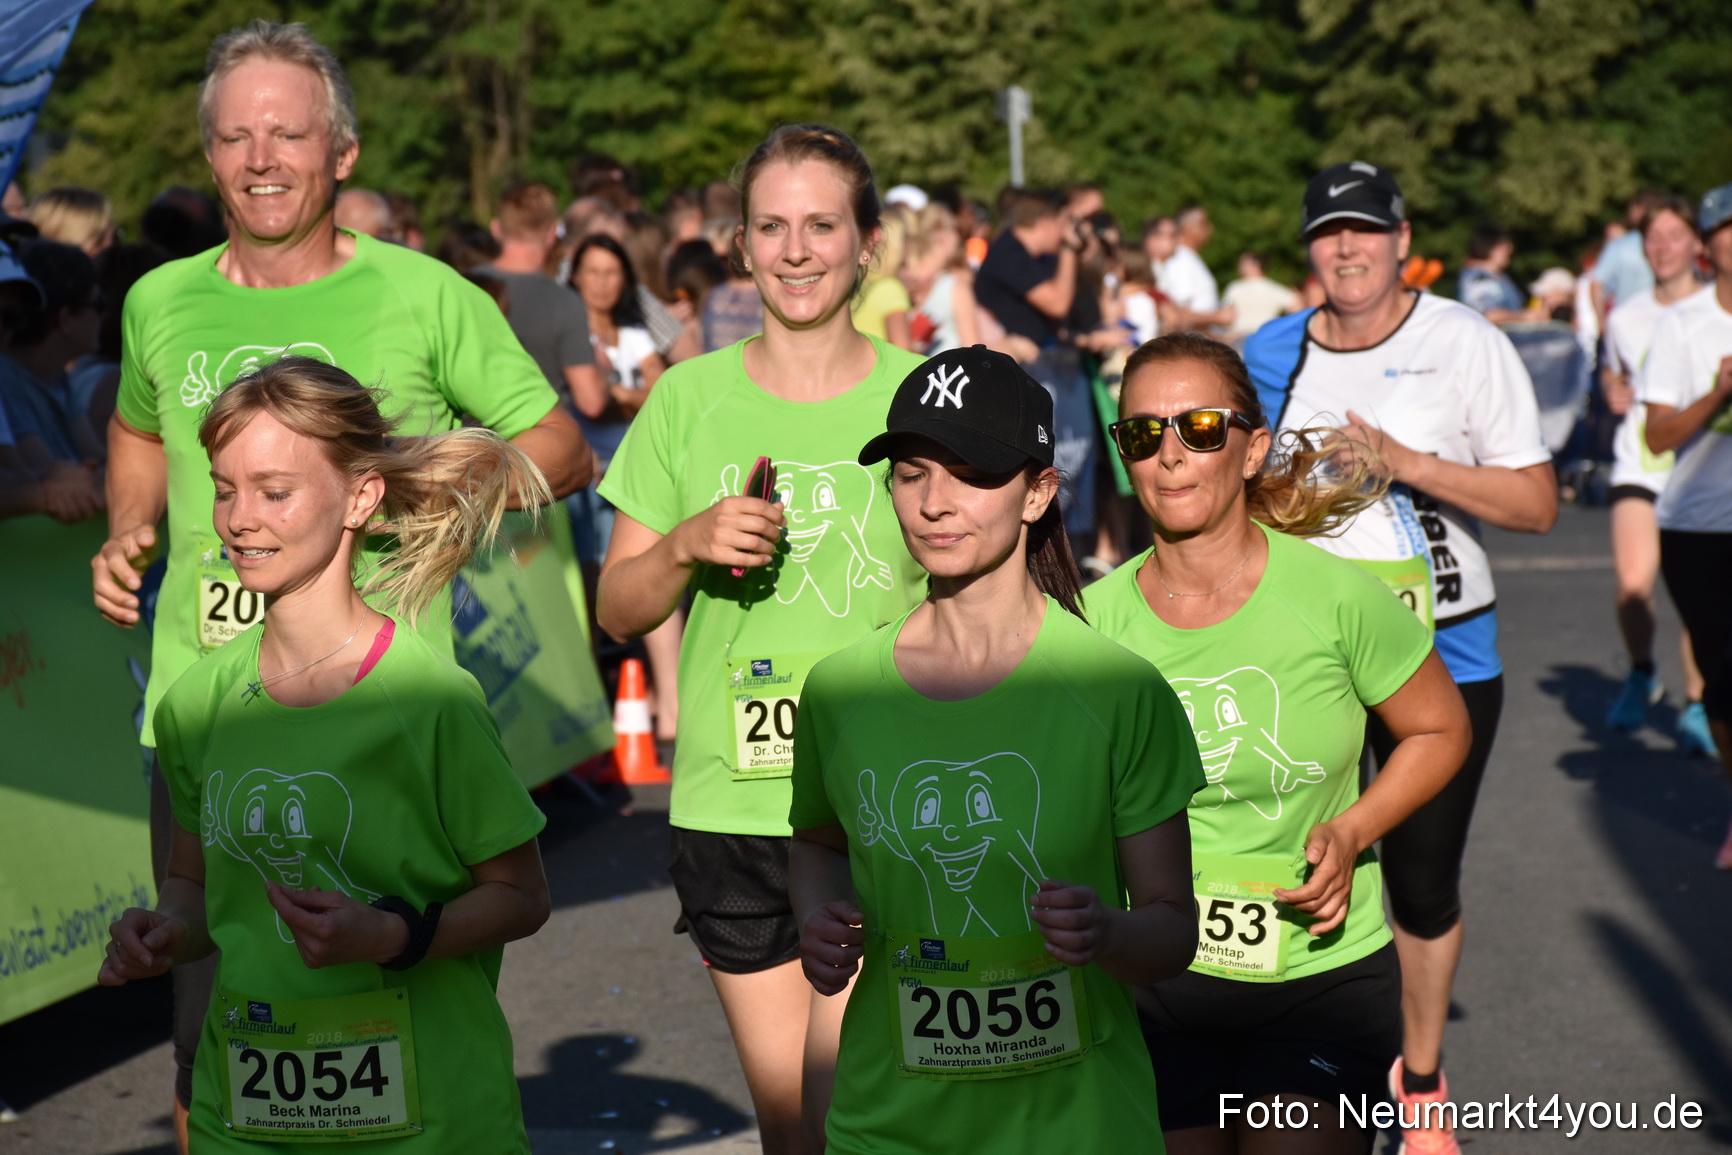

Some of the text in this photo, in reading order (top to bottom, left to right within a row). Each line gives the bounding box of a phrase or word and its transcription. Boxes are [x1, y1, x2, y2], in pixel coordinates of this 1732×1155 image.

[920, 363, 971, 410] NY
[744, 672, 793, 686] firmenlauf
[754, 746, 770, 756] Dr.
[1207, 882, 1239, 894] 2018
[1199, 942, 1245, 960] Mehtap
[910, 955, 971, 972] firmenlauf
[1203, 955, 1216, 964] Dr.
[1218, 958, 1264, 970] Schmiedel
[980, 968, 1016, 982] 2018
[911, 979, 1061, 1040] 2056
[238, 1017, 297, 1035] firmenlauf
[306, 1031, 343, 1044] 2018
[933, 1036, 1047, 1056] Hoxha Miranda
[918, 1056, 992, 1069] Zahnarztpraxis
[994, 1056, 1010, 1065] Dr.
[1012, 1044, 1066, 1062] Schmiedel
[239, 1045, 389, 1102] 2054
[269, 1104, 361, 1117] Beck Marina
[245, 1115, 390, 1129] Zahnarztpraxis Dr. Schmiedel
